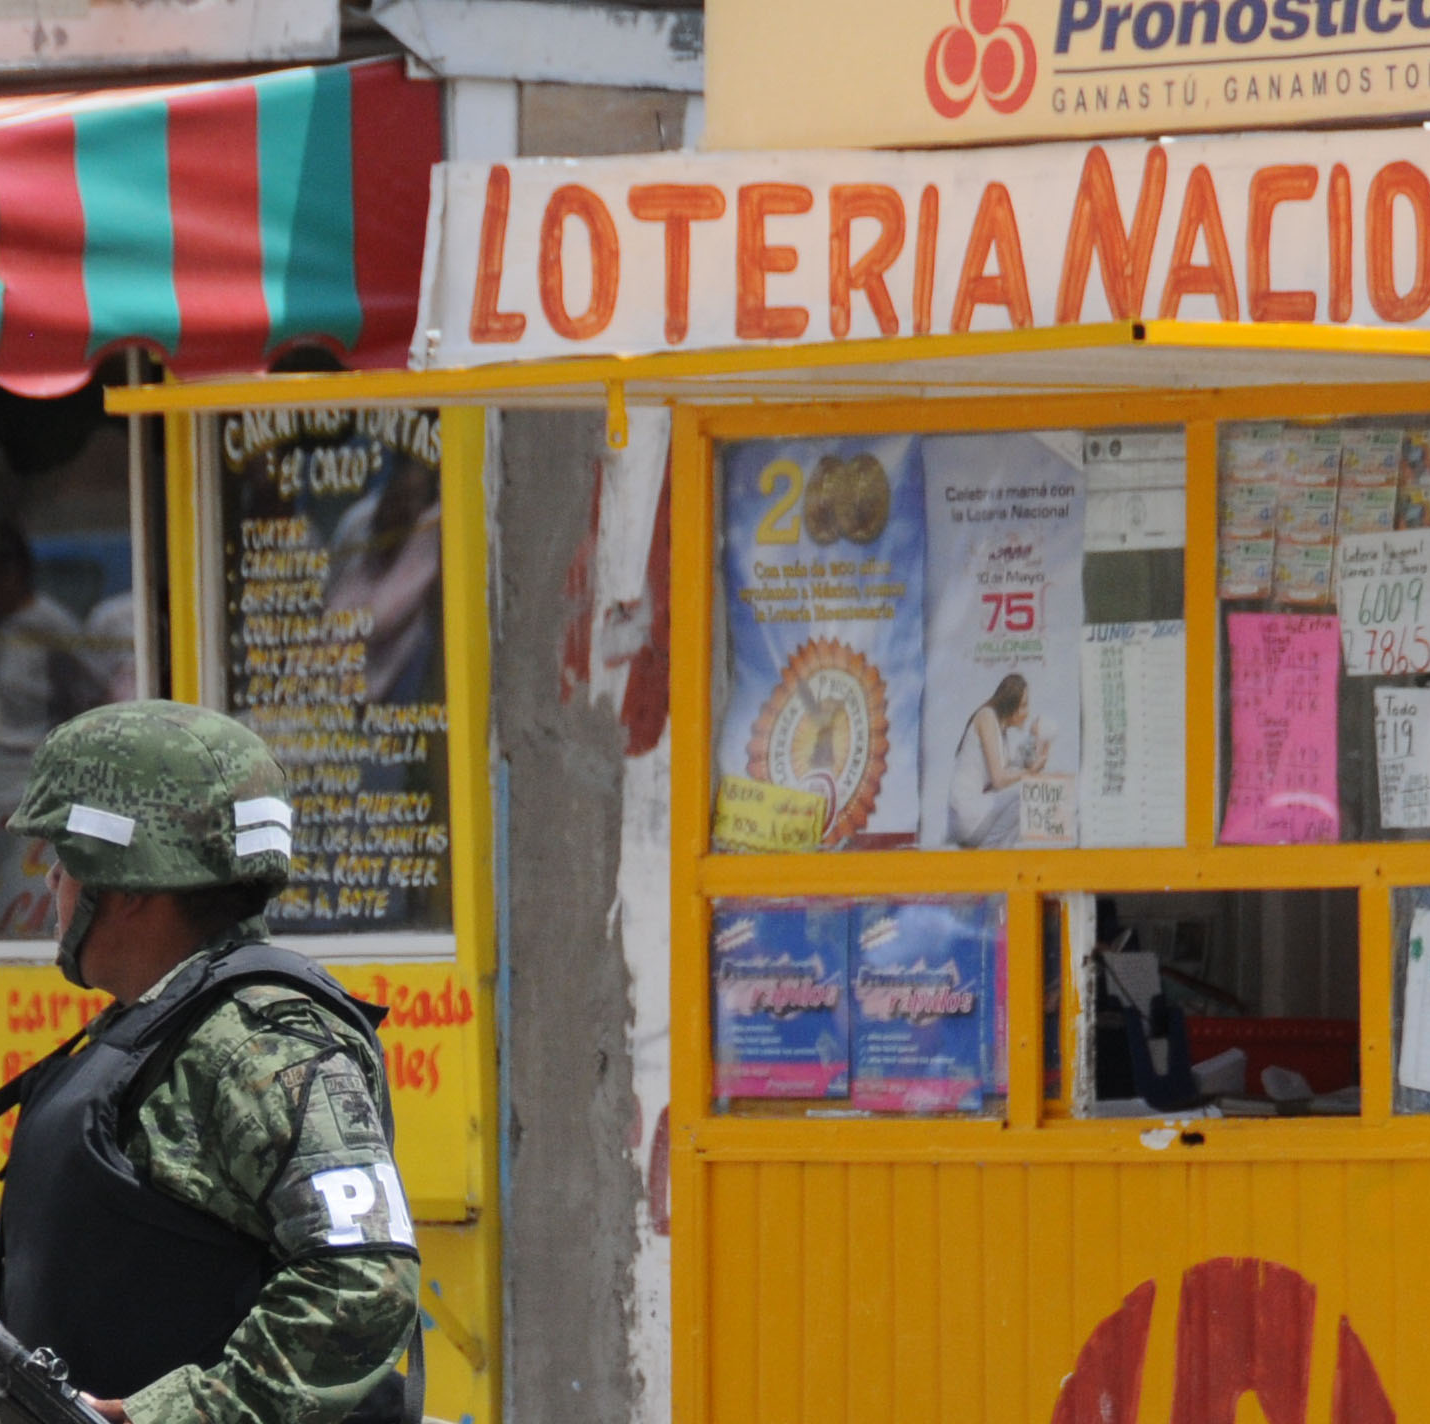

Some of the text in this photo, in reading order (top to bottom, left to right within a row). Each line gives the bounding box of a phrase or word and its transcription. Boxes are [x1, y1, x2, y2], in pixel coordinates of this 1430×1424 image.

[1052, 85, 1151, 114] GANAS
[1164, 73, 1211, 111] TÚ,
[1224, 66, 1372, 104] GANAMOS
[468, 163, 1033, 344] LOTERIA
[1006, 482, 1048, 500] mamá
[1050, 482, 1075, 498] con
[1010, 503, 1070, 520] Nacional
[1005, 568, 1045, 586] Mayo
[981, 591, 1035, 632] 75
[1358, 577, 1424, 626] 6009
[1383, 694, 1418, 717] Todo
[334, 853, 386, 885] ROOT
